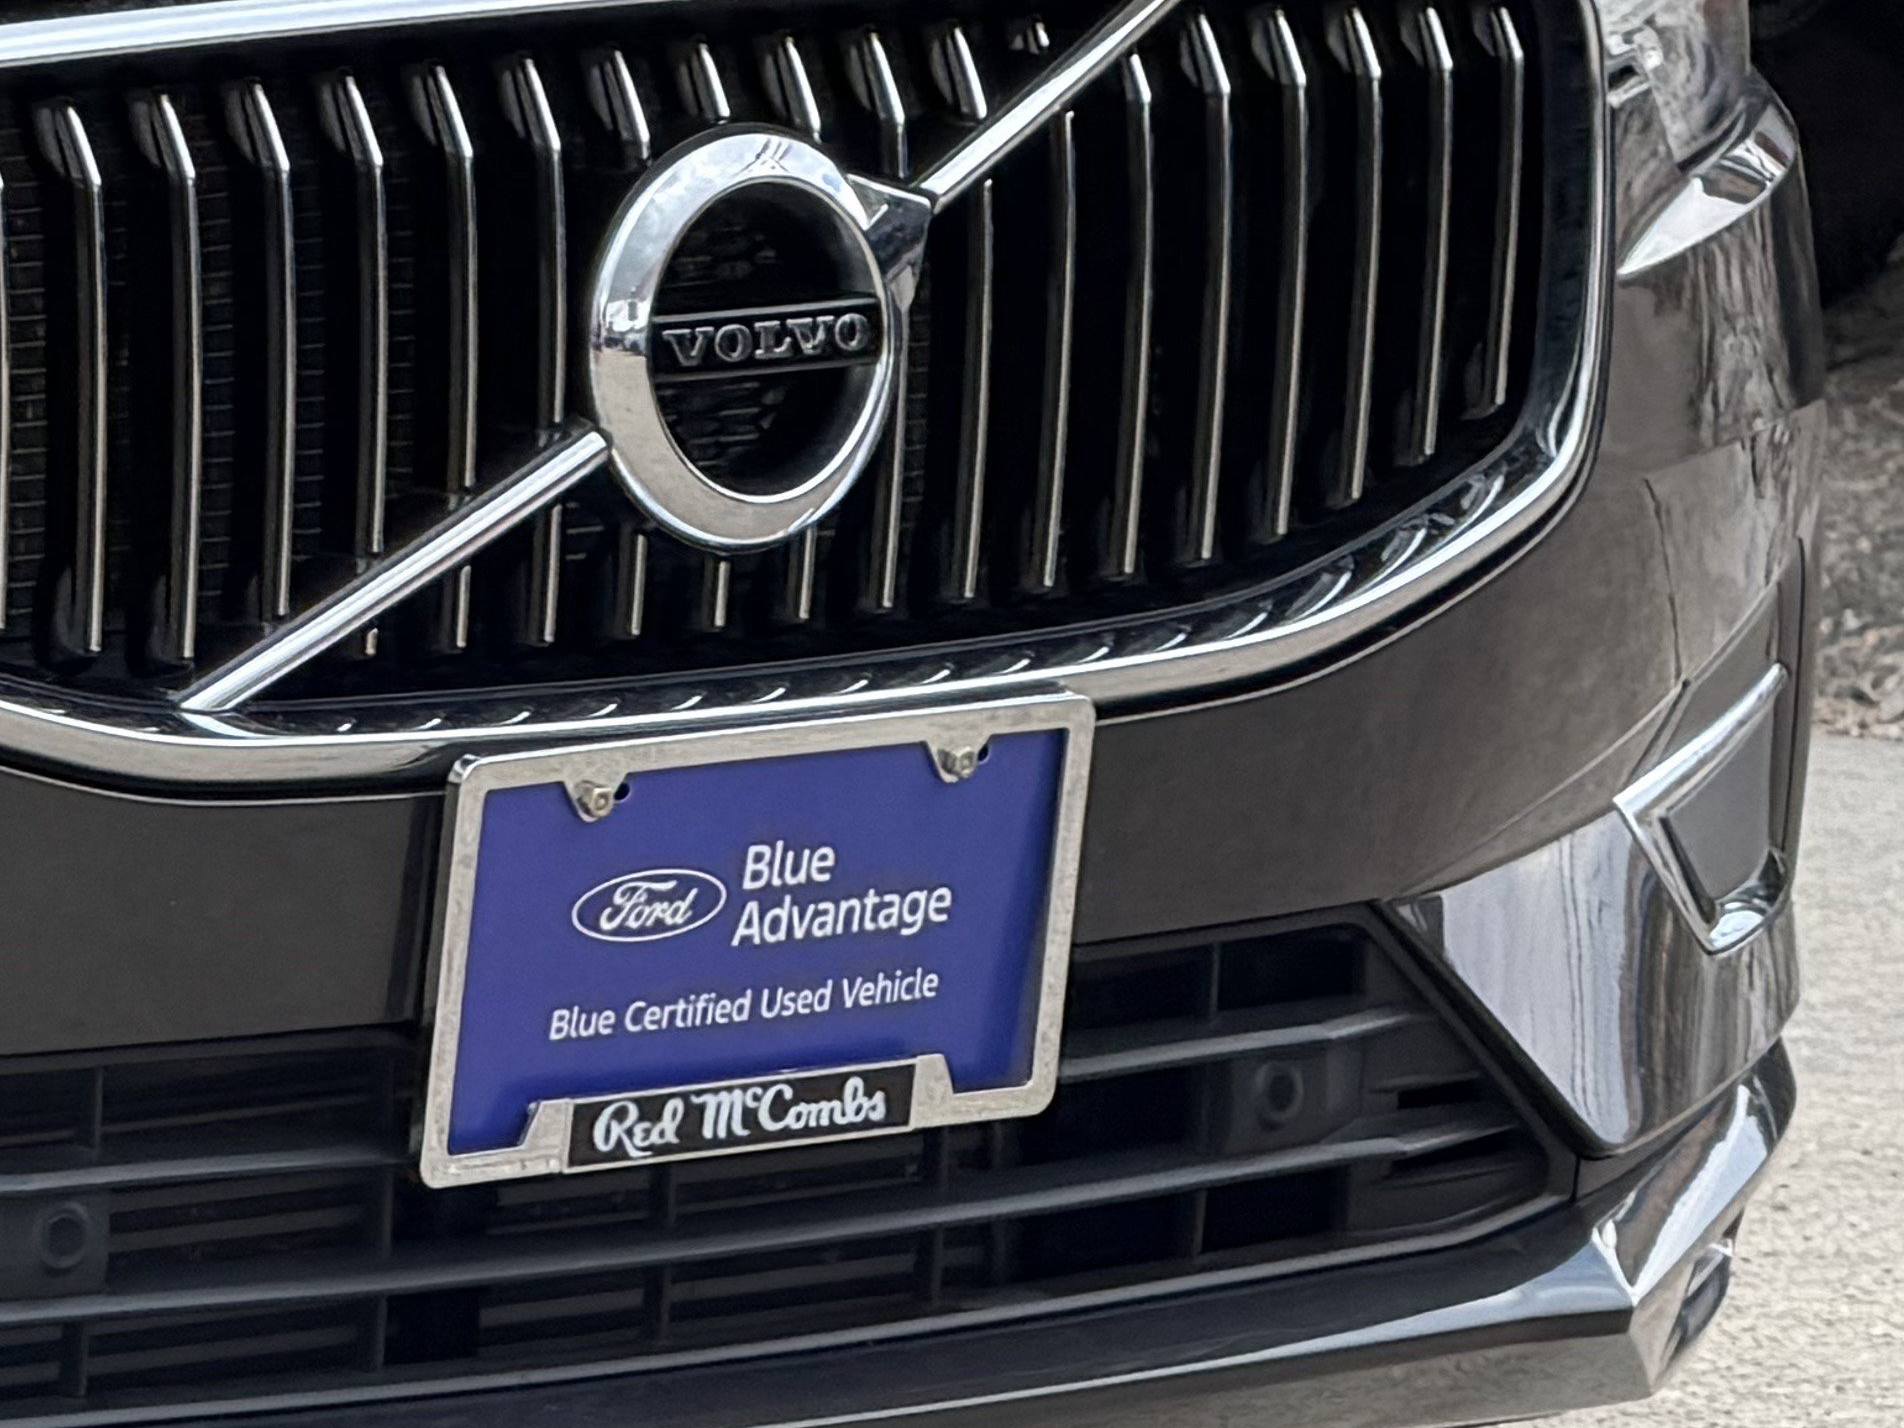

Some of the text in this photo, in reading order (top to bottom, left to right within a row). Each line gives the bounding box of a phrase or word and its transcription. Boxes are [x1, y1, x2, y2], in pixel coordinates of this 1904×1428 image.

[663, 313, 869, 366] VOLVO
[742, 839, 835, 889] Blue
[600, 881, 698, 930] Ford
[732, 885, 952, 946] Advantage
[549, 966, 939, 1041] Blue Certified Used Vehicle
[593, 1074, 885, 1157] Red McCombs
